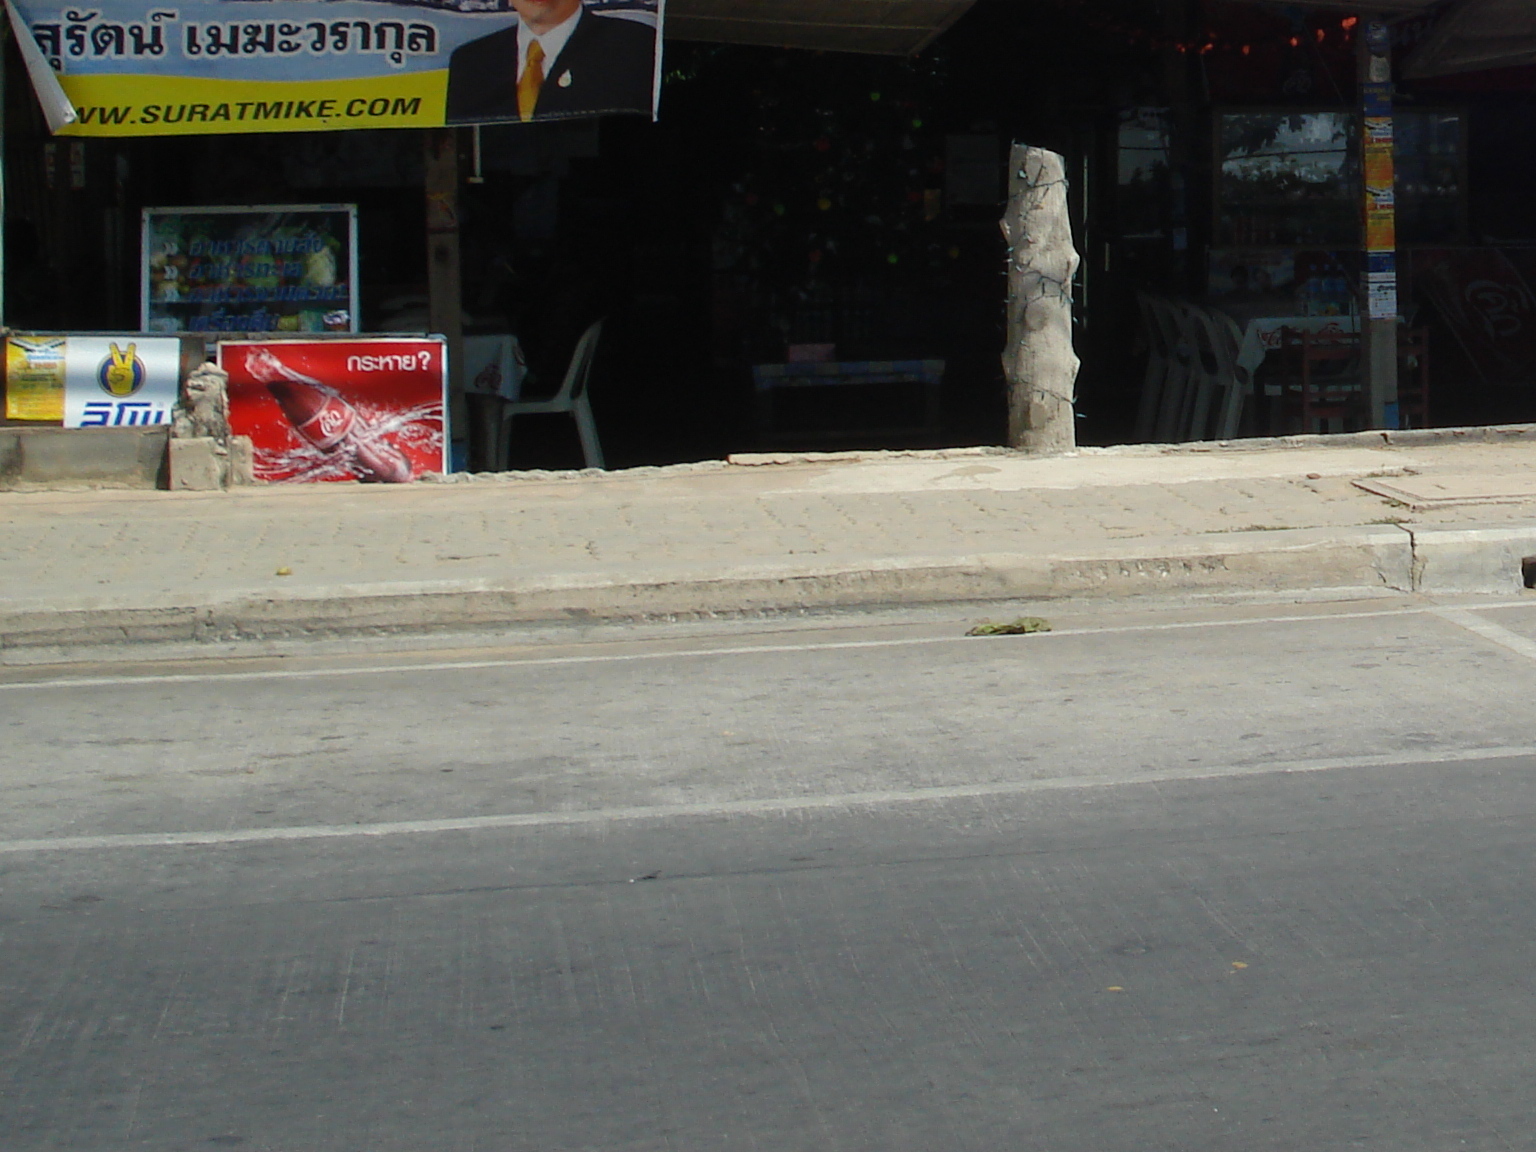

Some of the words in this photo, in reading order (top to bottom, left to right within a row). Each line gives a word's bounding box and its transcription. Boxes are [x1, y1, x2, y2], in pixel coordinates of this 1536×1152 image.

[72, 96, 421, 126] WW.SURATMIKE.COM
[346, 350, 432, 372] กระหาย?
